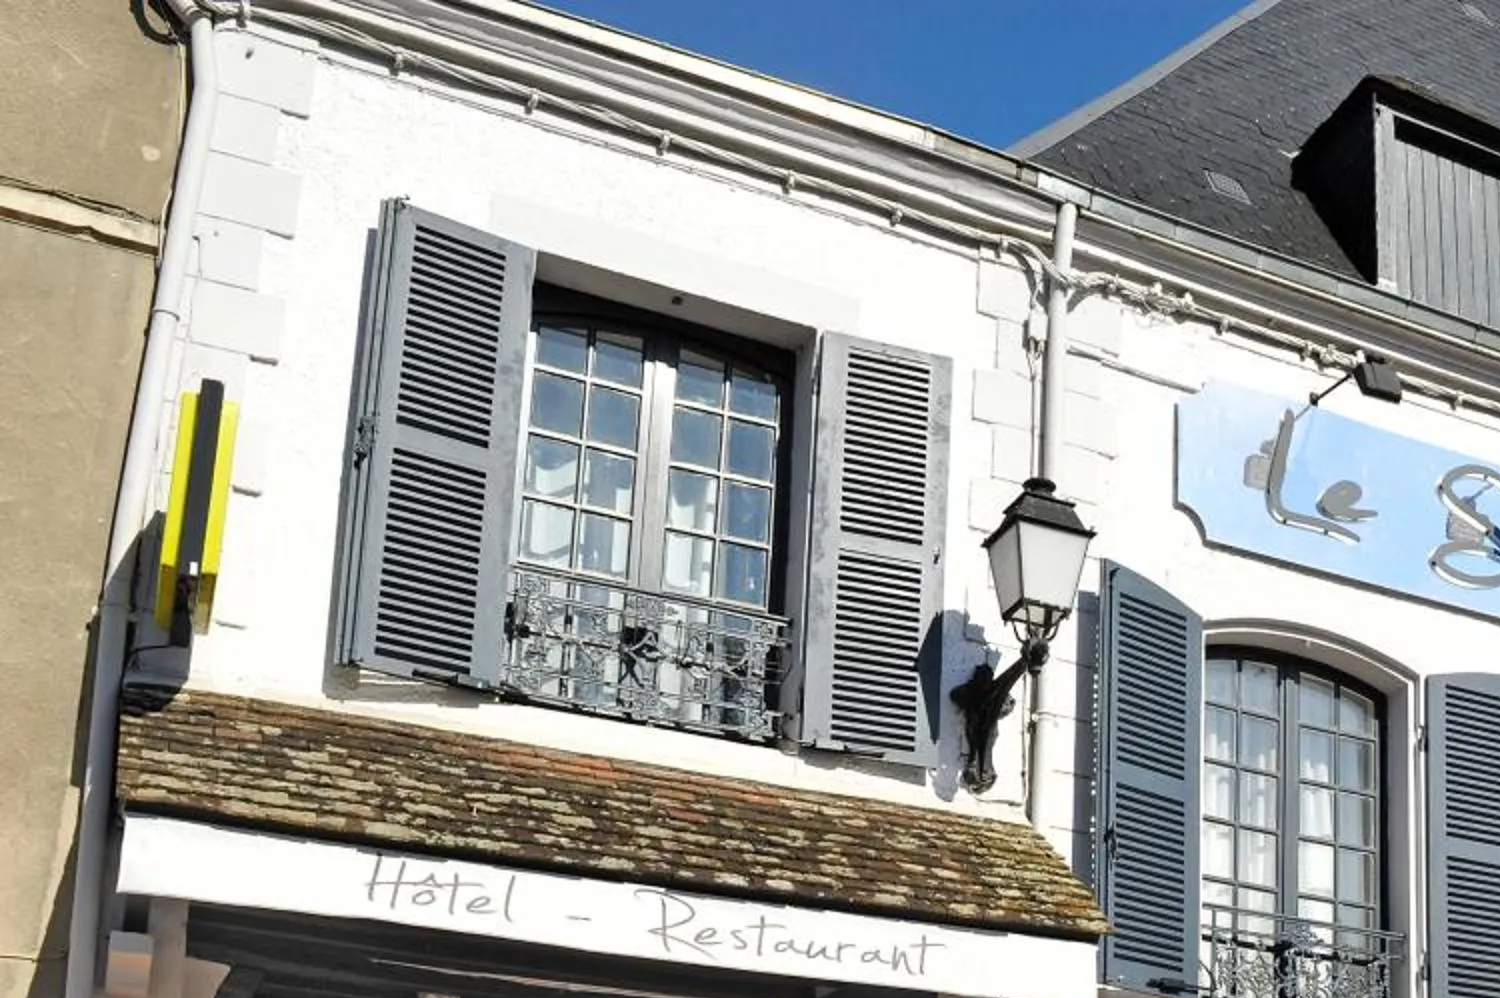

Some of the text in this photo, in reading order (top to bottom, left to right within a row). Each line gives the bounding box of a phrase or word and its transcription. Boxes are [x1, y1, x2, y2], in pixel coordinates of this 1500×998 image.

[1265, 408, 1378, 543] Le
[364, 851, 516, 923] Hôtel
[633, 888, 945, 975] Restaurant
